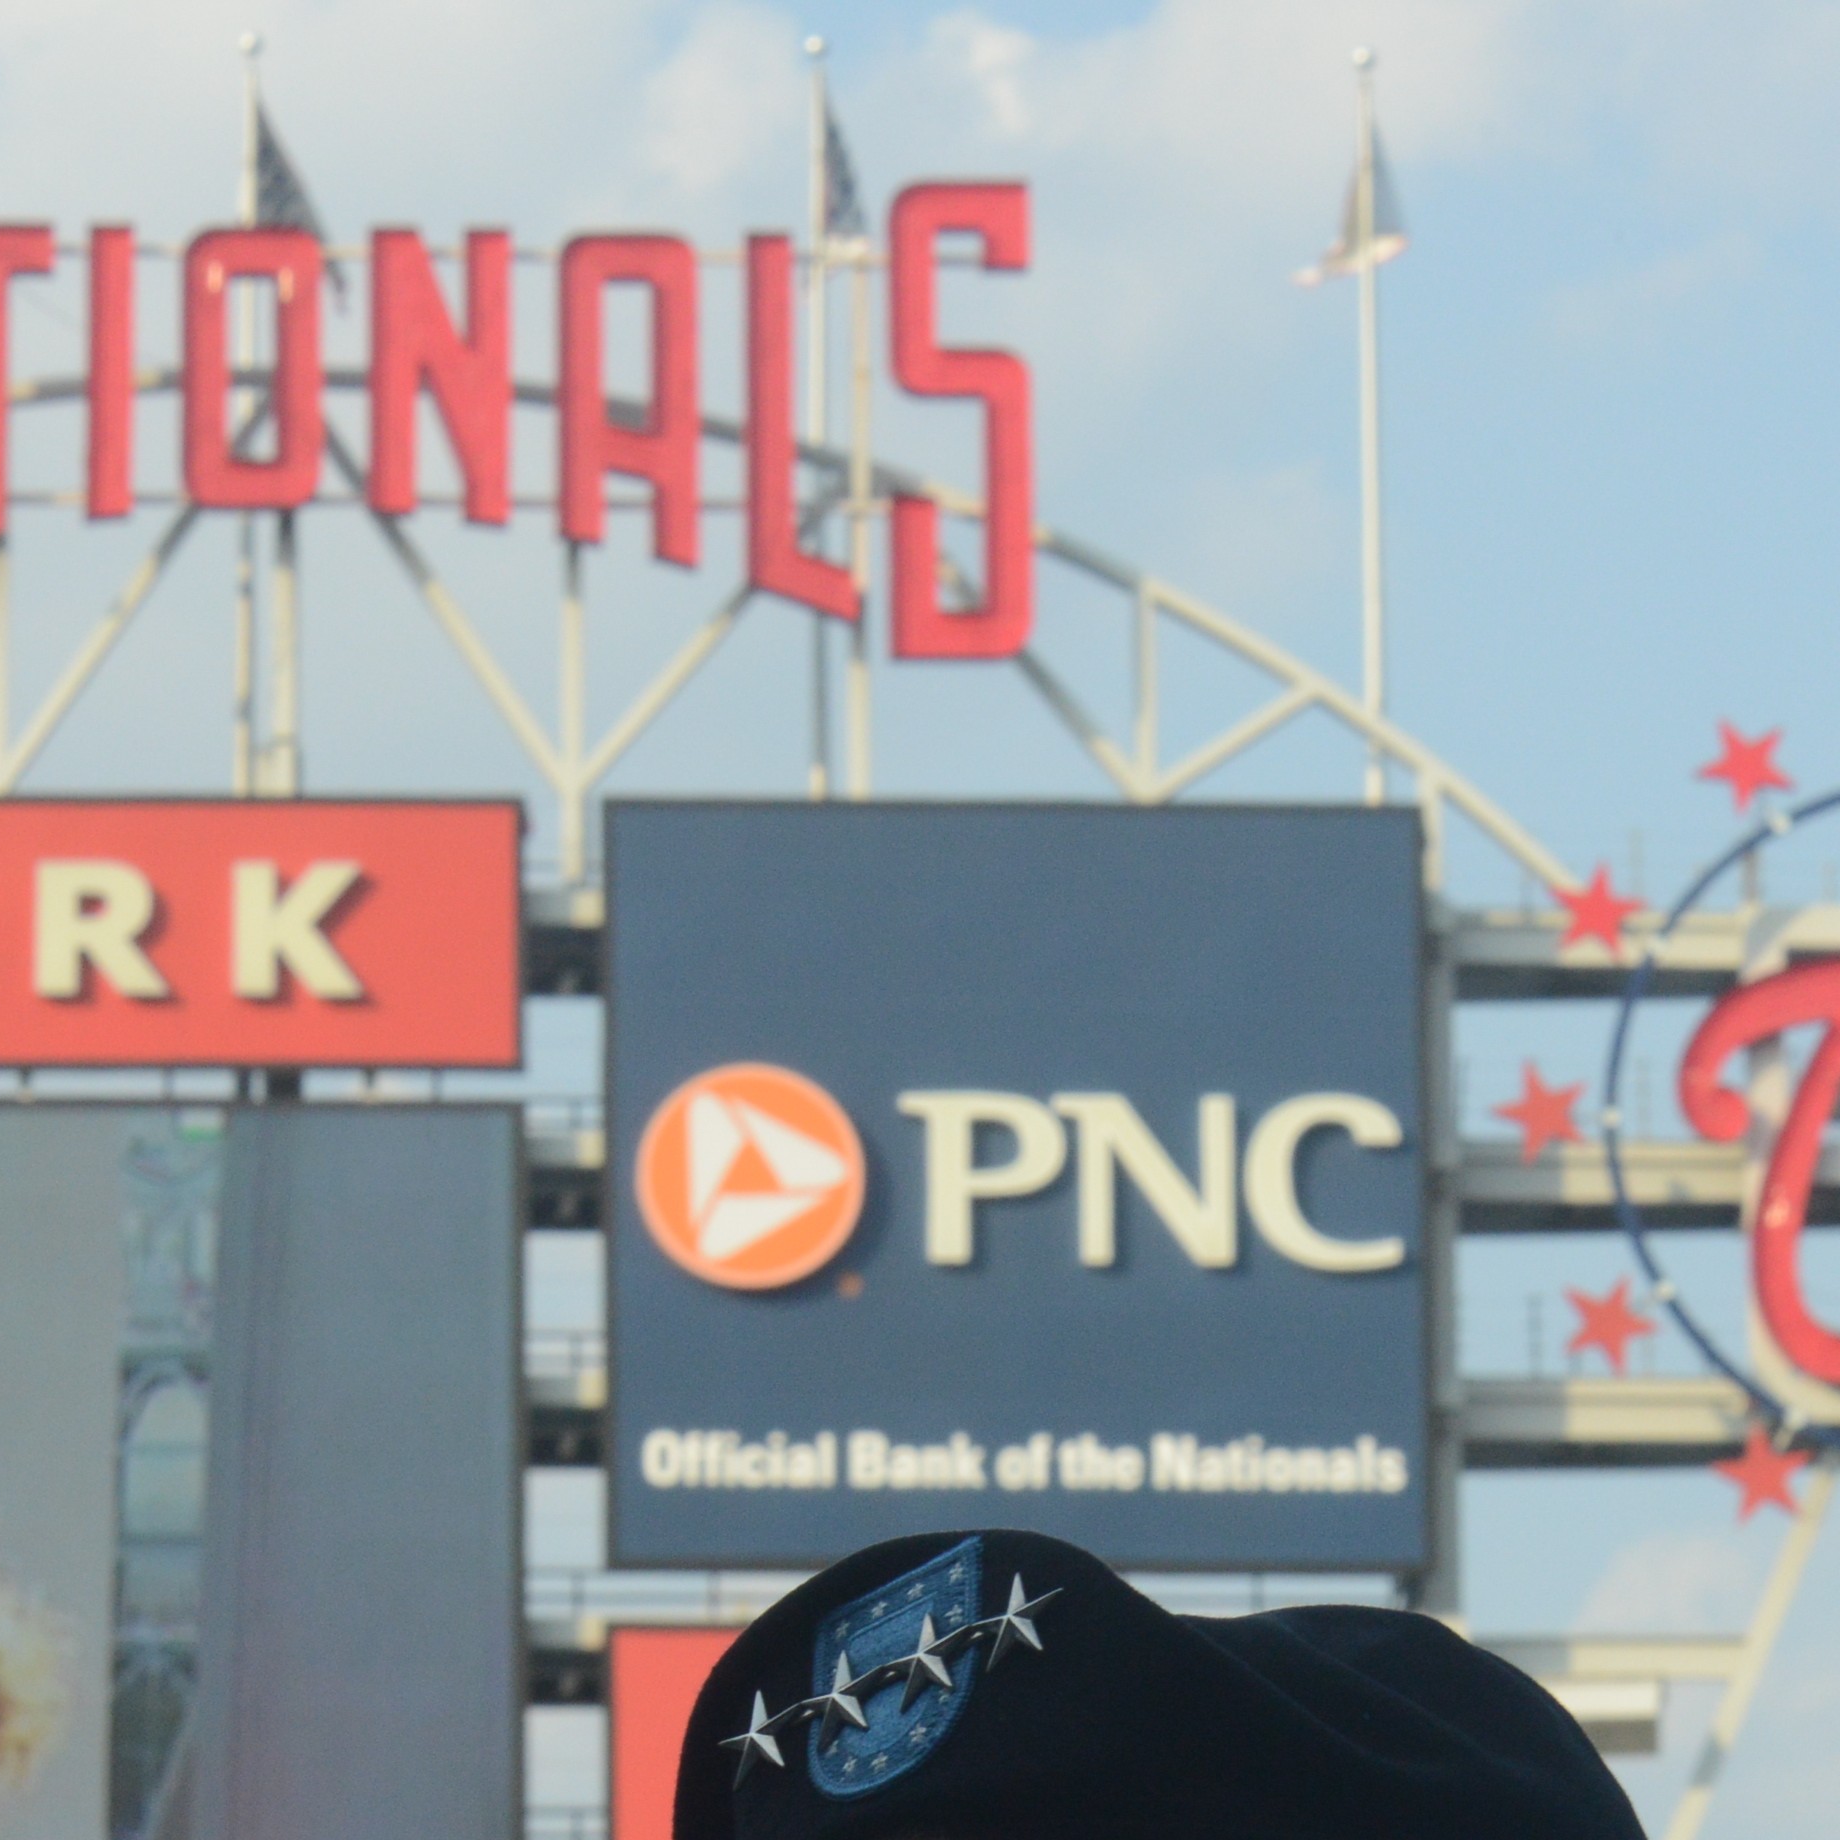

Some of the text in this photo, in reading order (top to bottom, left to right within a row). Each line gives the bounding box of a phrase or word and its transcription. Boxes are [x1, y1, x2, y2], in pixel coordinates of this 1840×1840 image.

[895, 1089, 1406, 1273] PNC
[641, 1426, 1408, 1493] Official Bank of the Nationals
